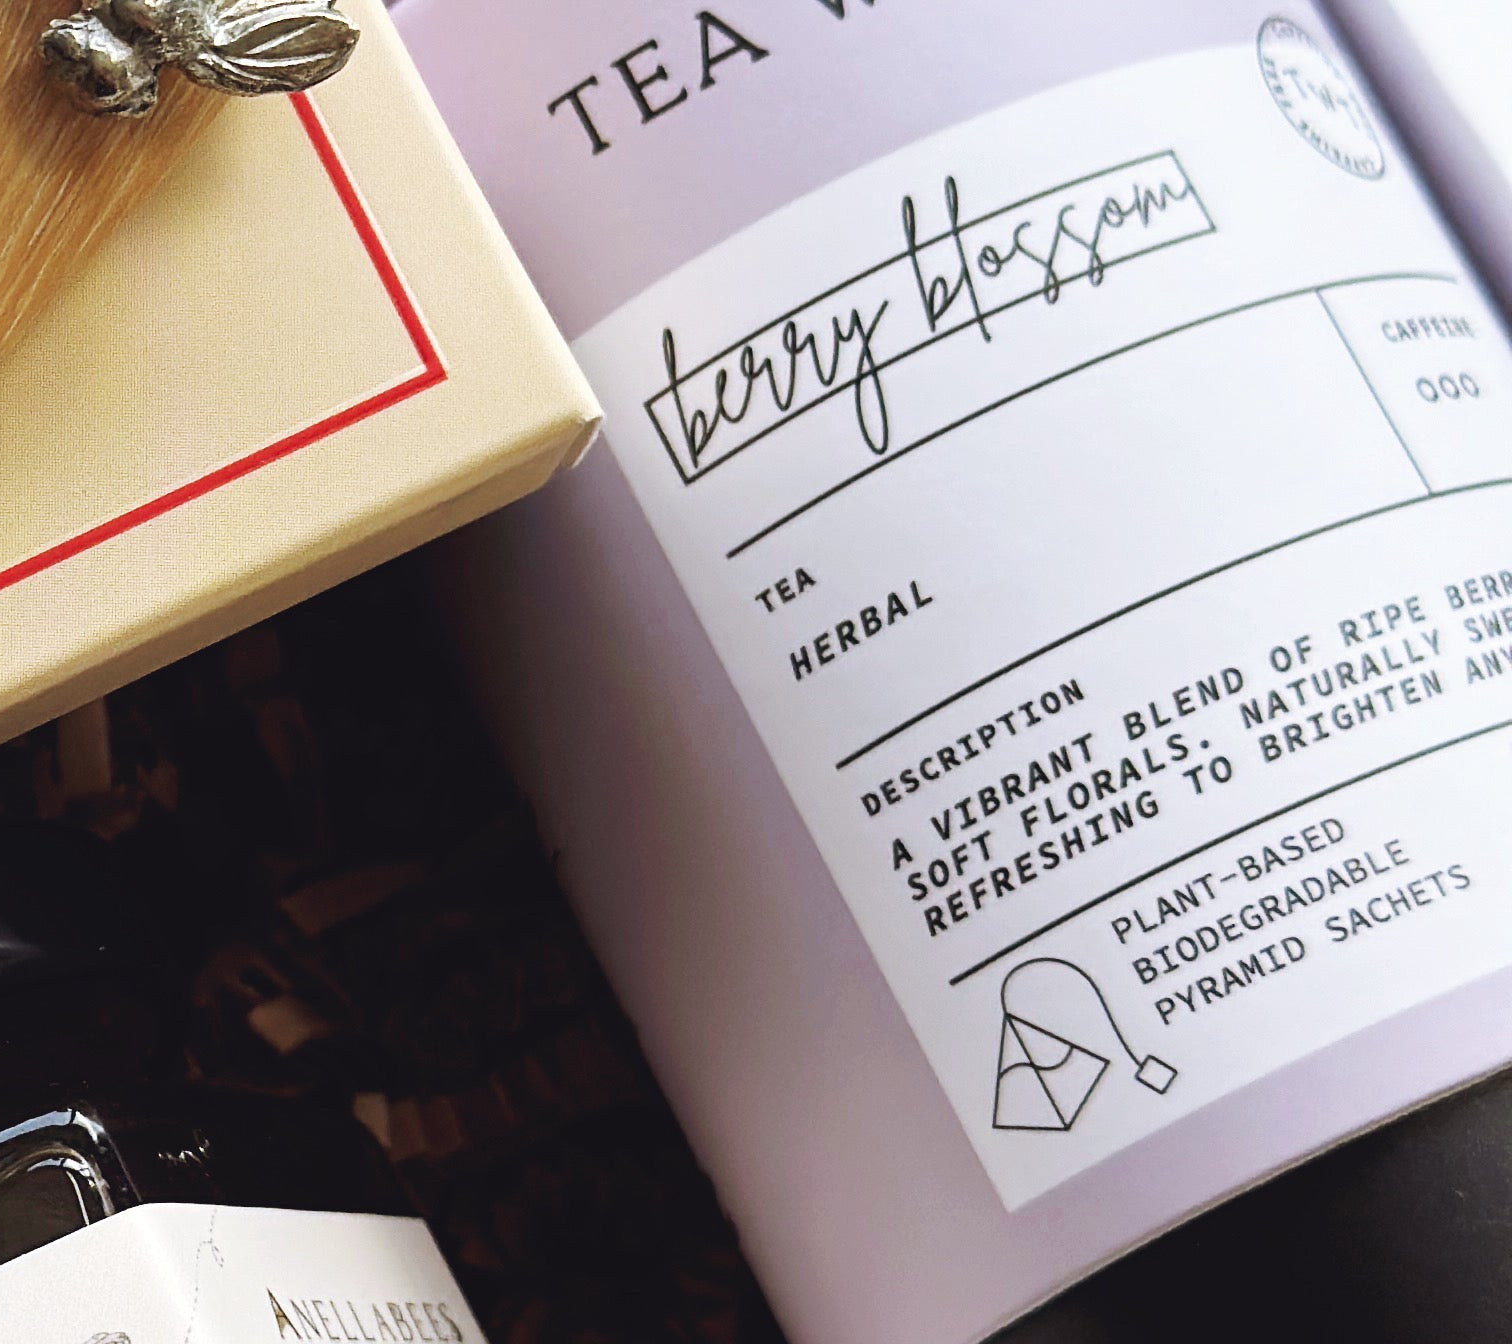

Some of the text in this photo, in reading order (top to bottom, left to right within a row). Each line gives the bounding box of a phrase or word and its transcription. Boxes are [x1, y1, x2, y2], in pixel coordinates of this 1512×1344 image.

[547, 9, 771, 155] TEA
[663, 175, 1193, 456] berry blossom
[755, 567, 817, 613] TEA
[790, 580, 934, 682] HERBAL
[860, 678, 1086, 818] DESCRIPTION
[892, 837, 914, 872] A
[931, 732, 1093, 841] VIBRANT
[1122, 666, 1245, 741] BLEND
[1269, 634, 1313, 673] OF
[1337, 594, 1426, 648] RIPE
[906, 830, 993, 902] SOFT
[1019, 732, 1210, 837] FLORALS.
[1239, 628, 1440, 730] NATURALLY
[923, 790, 1160, 937] REFRESHING
[1182, 755, 1233, 796] TO
[1258, 669, 1444, 763] BRIGHTEN
[1110, 817, 1346, 945] PLANT-BASED
[1131, 838, 1411, 986] BIODEGRADABLE
[1153, 863, 1472, 1026] PYRAMID SACHETS
[266, 1286, 465, 1343] ANELLABEES
